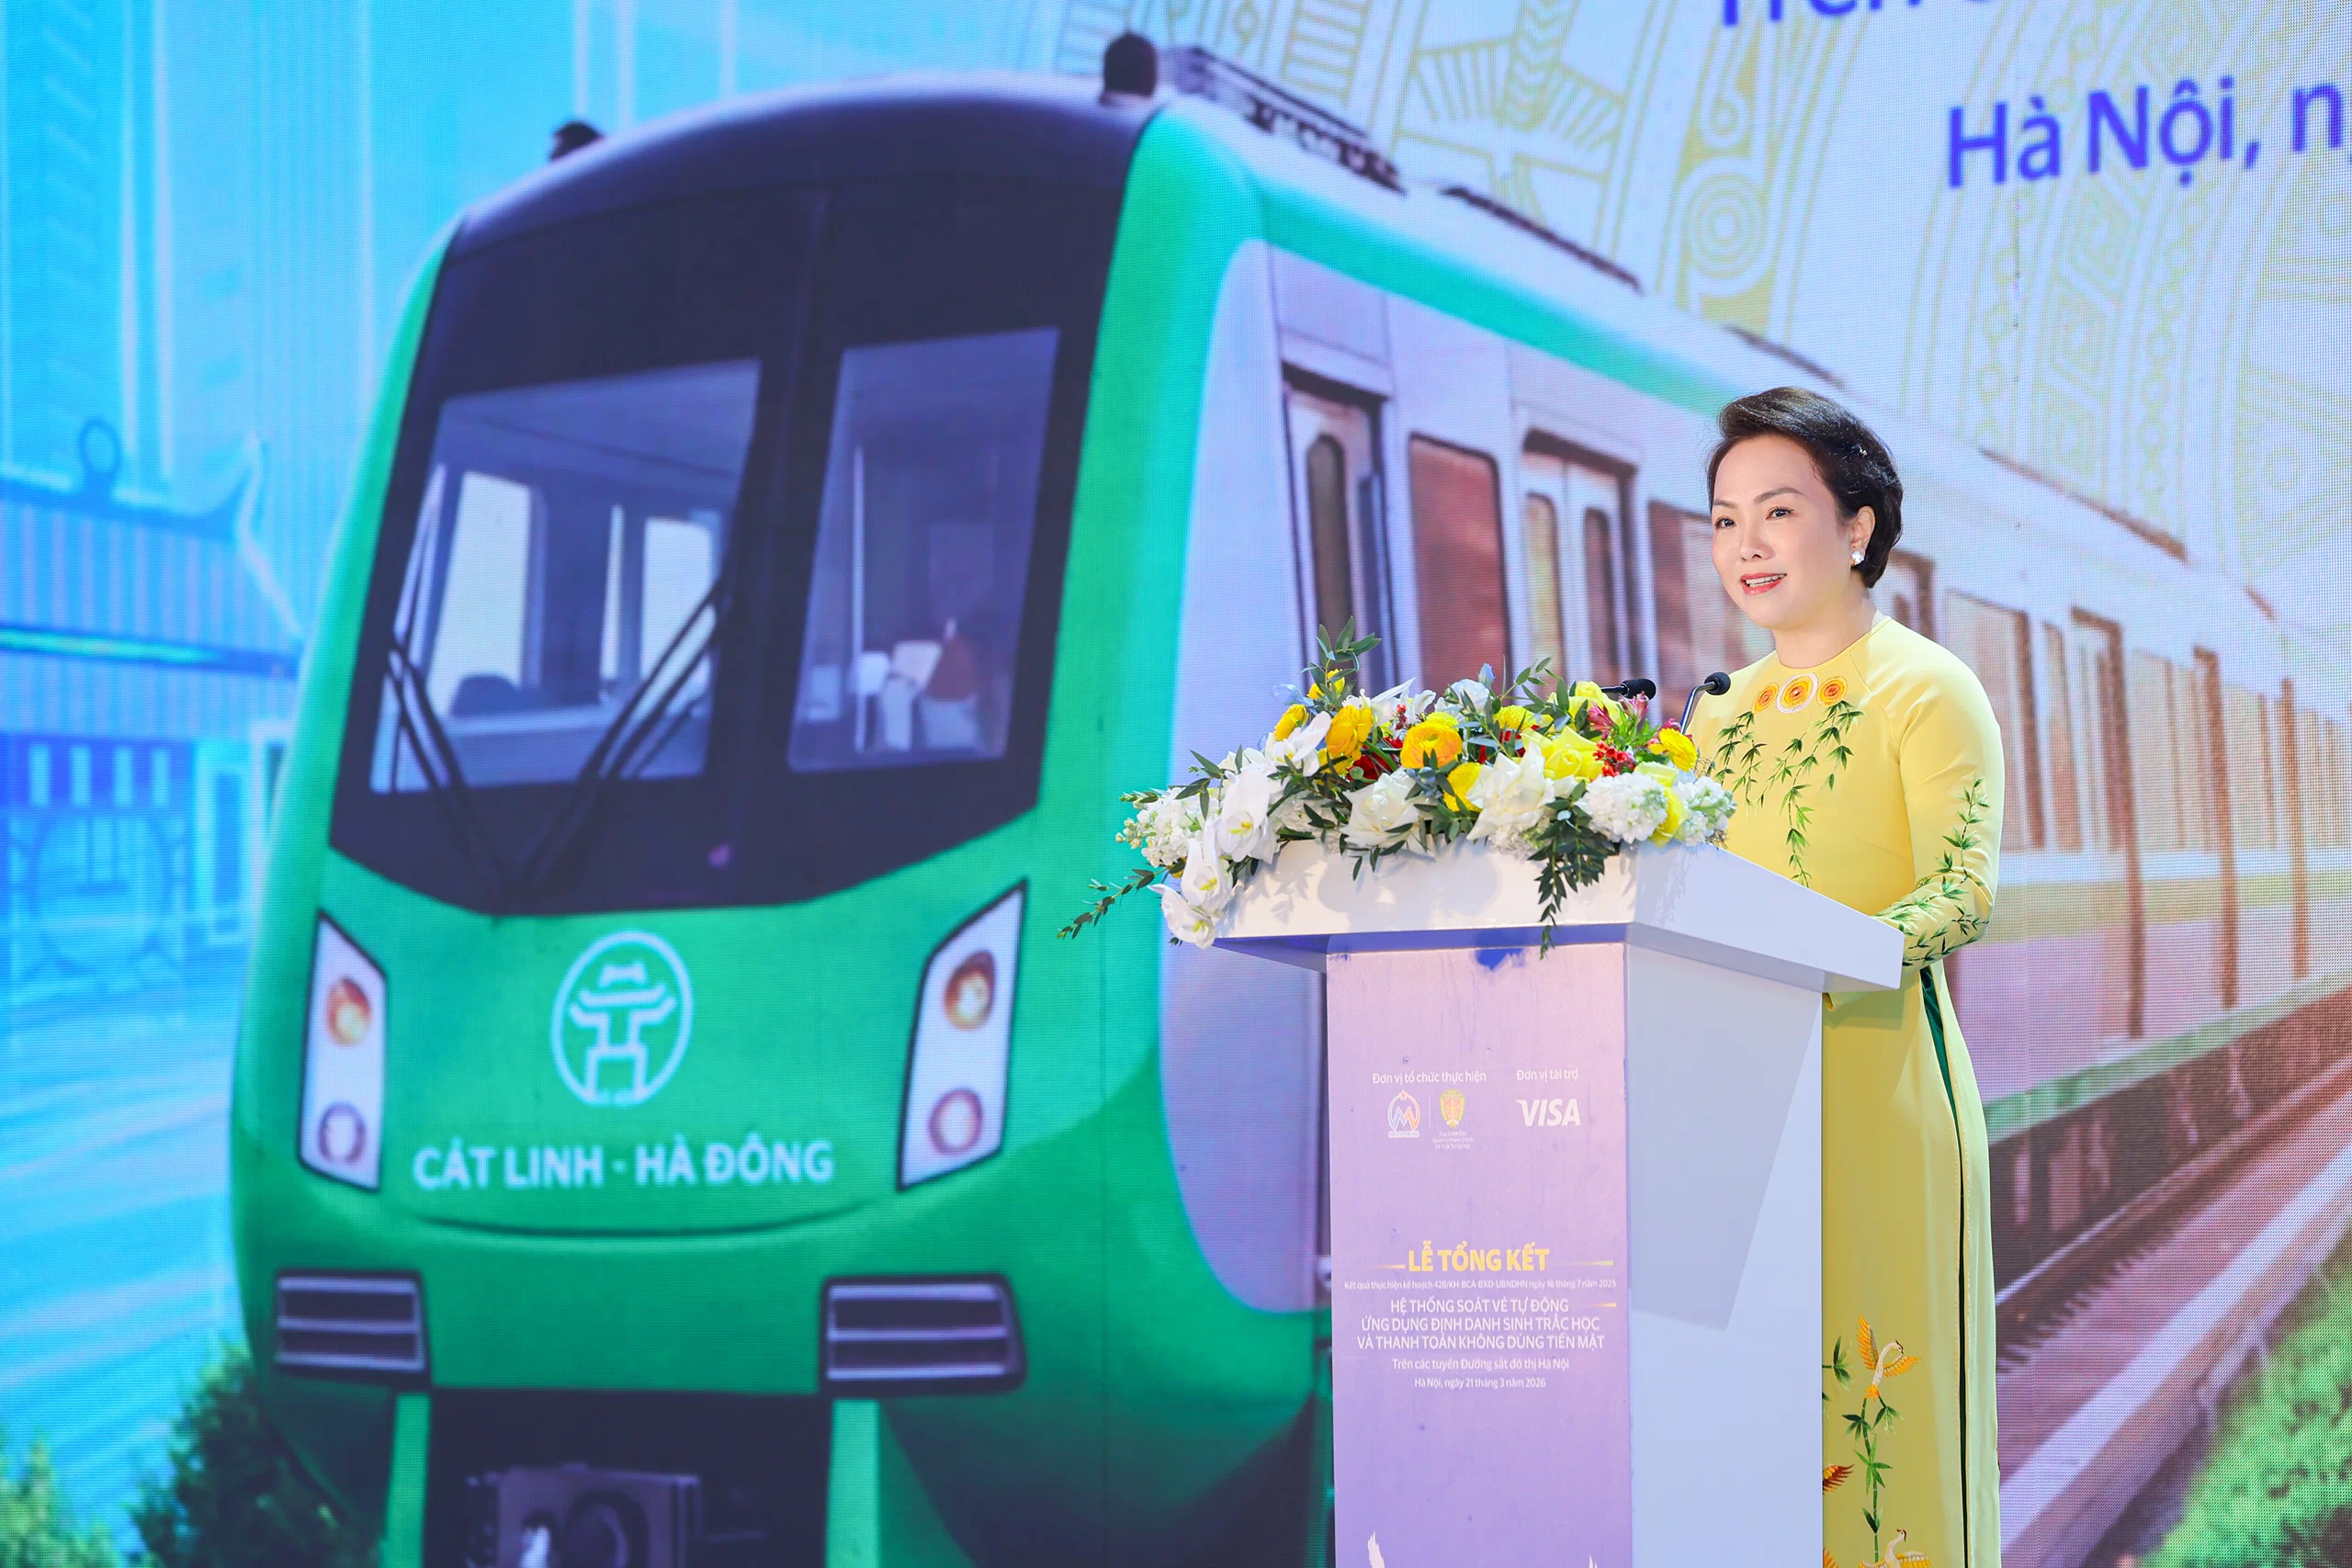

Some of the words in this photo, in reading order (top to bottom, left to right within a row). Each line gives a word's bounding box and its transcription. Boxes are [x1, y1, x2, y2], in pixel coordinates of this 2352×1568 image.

[1948, 96, 2062, 188] Hà
[2087, 75, 2261, 187] Nội,
[2291, 82, 2352, 165] n
[1373, 1073, 1393, 1084] Đơn
[1394, 1073, 1403, 1086] vị
[1404, 1070, 1415, 1083] tổ
[1416, 1071, 1441, 1083] chức
[1442, 1070, 1464, 1084] thực
[1464, 1070, 1487, 1084] hiện
[1516, 1069, 1537, 1080] Đơn
[1539, 1068, 1548, 1082] vị
[1549, 1067, 1562, 1080] tài
[1564, 1067, 1579, 1082] trợ
[1516, 1098, 1581, 1127] VISA
[413, 1136, 498, 1190] CÁT
[503, 1145, 605, 1189] LINH
[635, 1132, 698, 1187] HÀ
[704, 1131, 835, 1185] ĐÔNG
[1408, 1240, 1434, 1272] LỄ
[1437, 1240, 1502, 1272] TỔNG
[1506, 1241, 1550, 1271] KẾT
[1390, 1296, 1408, 1315] HỆ
[1409, 1295, 1454, 1314] THỐNG
[1456, 1296, 1490, 1313] SOÁT
[1491, 1295, 1509, 1313] VÉ
[1510, 1295, 1529, 1315] TỰ
[1530, 1295, 1569, 1315] ĐỘNG
[1361, 1314, 1389, 1331] ỨNG
[1392, 1317, 1429, 1334] DỤNG
[1430, 1317, 1463, 1334] ĐỊNH
[1464, 1317, 1501, 1331] DANH
[1503, 1316, 1533, 1331] SINH
[1535, 1313, 1569, 1331] TRẮC
[1571, 1316, 1600, 1334] HỌC
[1357, 1333, 1374, 1349] VÀ
[1375, 1336, 1419, 1349] THANH
[1421, 1333, 1456, 1349] TOÁN
[1458, 1333, 1505, 1349] KHÔNG
[1507, 1333, 1544, 1349] DÙNG
[1546, 1332, 1575, 1349] TIỀN
[1577, 1333, 1606, 1352] MẶT
[1392, 1358, 1413, 1370] Trên
[1414, 1358, 1430, 1370] các
[1432, 1358, 1459, 1371] tuyến
[1461, 1358, 1493, 1372] Đường
[1494, 1357, 1508, 1370] sắt
[1510, 1358, 1522, 1370] đô
[1524, 1358, 1537, 1371] thị
[1538, 1357, 1552, 1370] Hà
[1553, 1357, 1570, 1371] Nội
[1414, 1378, 1426, 1388] Hà
[1427, 1377, 1443, 1389] Nội,
[1444, 1378, 1464, 1390] ngày
[1465, 1378, 1474, 1388] 21
[1475, 1378, 1498, 1390] tháng
[1499, 1378, 1505, 1388] 3
[1506, 1378, 1524, 1388] năm
[1525, 1377, 1546, 1388] 2026
